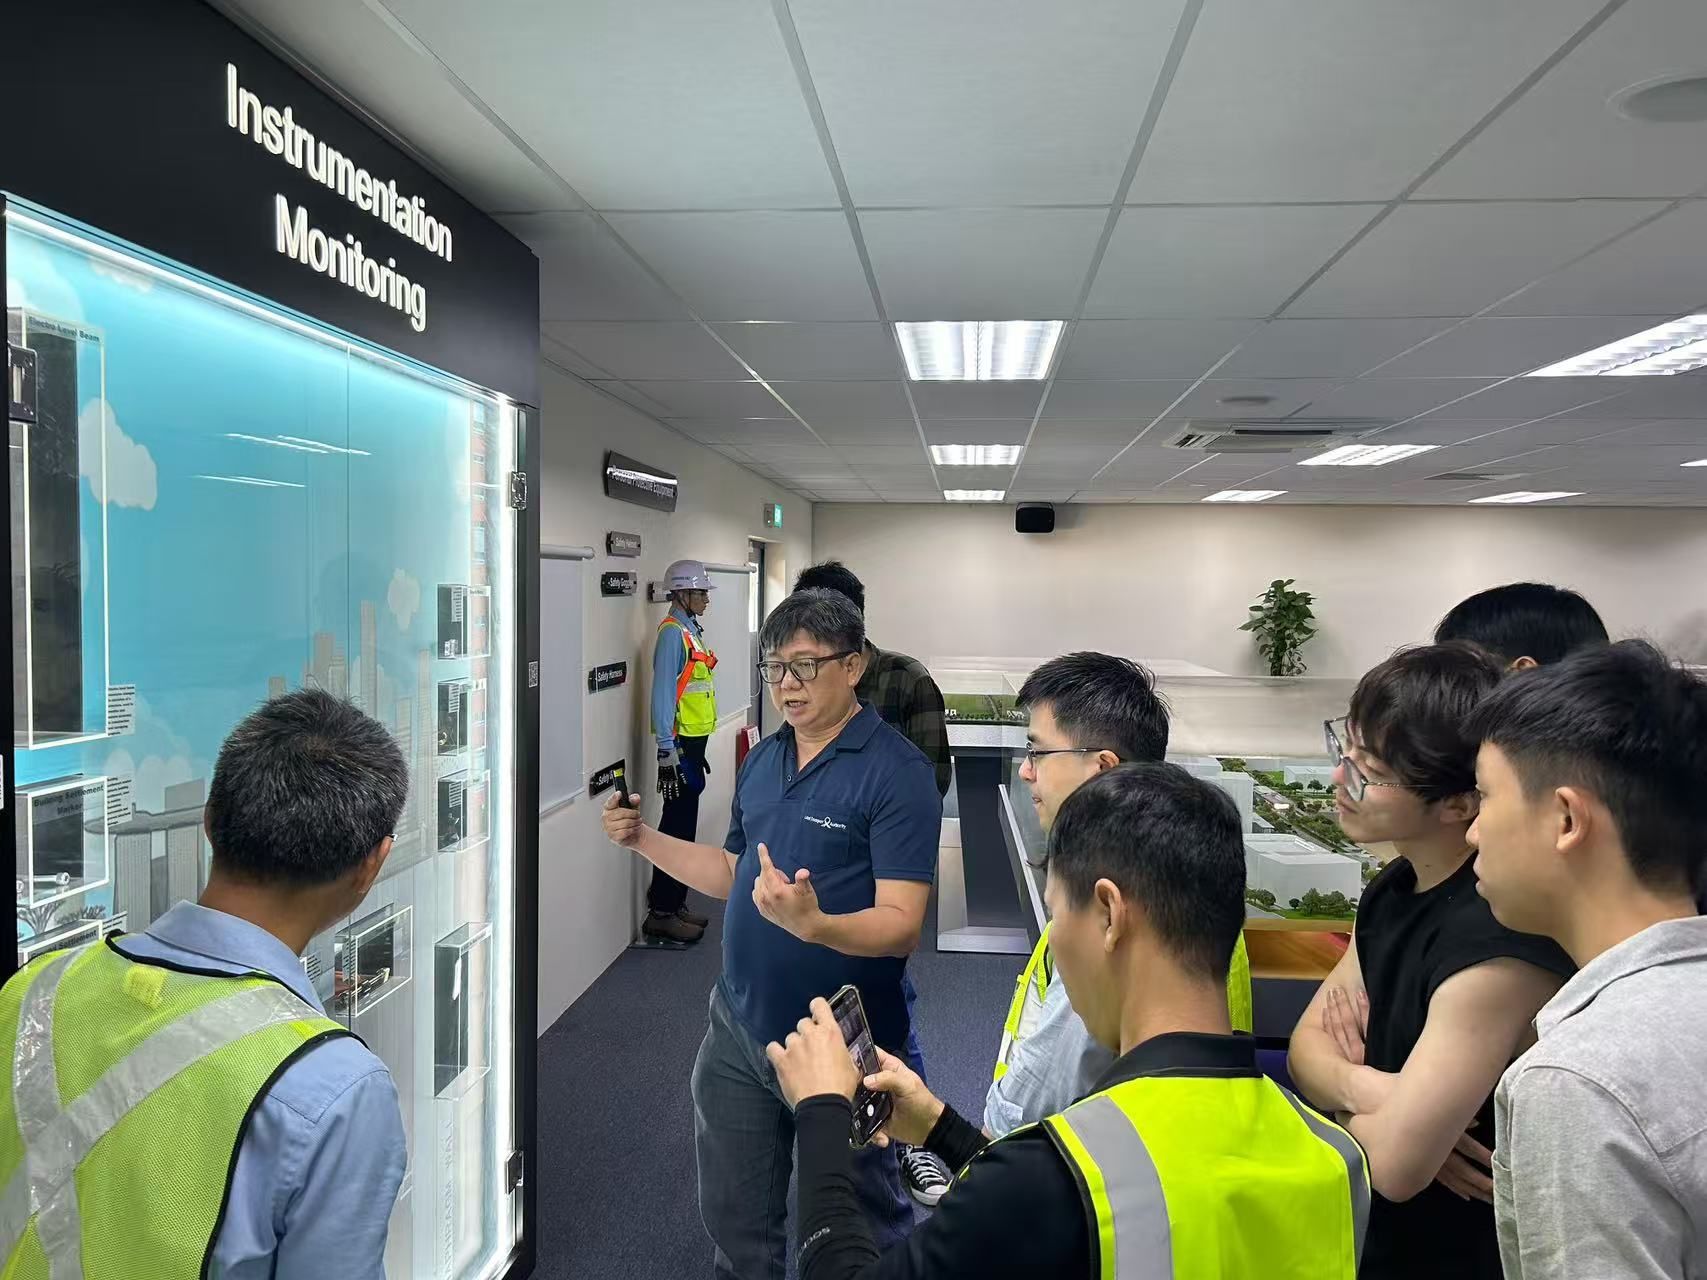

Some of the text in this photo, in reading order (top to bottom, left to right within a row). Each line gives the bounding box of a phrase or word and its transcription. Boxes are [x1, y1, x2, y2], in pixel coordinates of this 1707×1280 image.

[227, 62, 452, 263] Instrumentation
[275, 193, 426, 332] Monitoring
[80, 329, 100, 341] Beam
[597, 671, 608, 682] Safety
[64, 785, 104, 800] Settlement
[60, 930, 97, 948] Settlement
